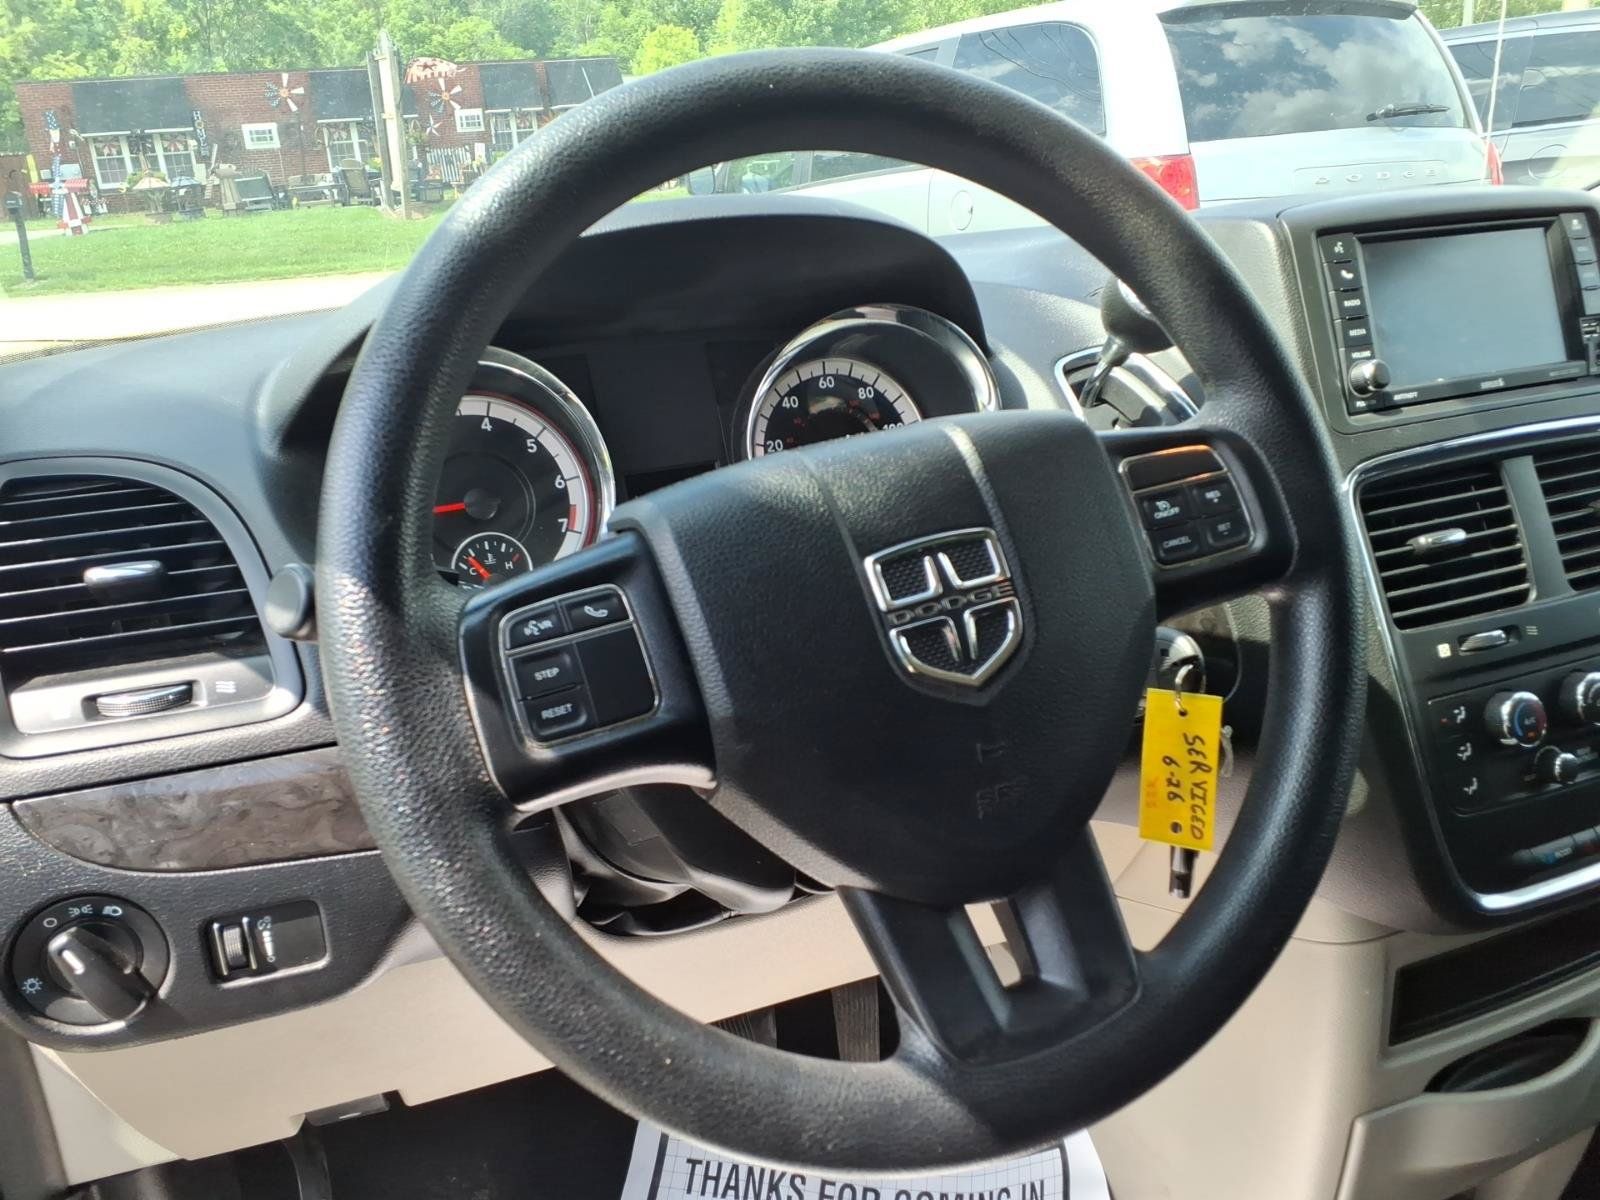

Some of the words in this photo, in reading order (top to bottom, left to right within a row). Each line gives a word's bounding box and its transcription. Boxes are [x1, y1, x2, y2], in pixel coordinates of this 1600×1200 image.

[1315, 168, 1440, 185] DODGE
[818, 375, 835, 389] 60
[858, 386, 875, 399] 80
[782, 395, 799, 409] 40
[481, 417, 493, 432] 4
[526, 439, 538, 453] 5
[766, 439, 784, 453] 20
[555, 475, 566, 489] 6
[557, 518, 569, 533] 7
[469, 566, 478, 576] C
[505, 561, 514, 570] H
[888, 581, 1014, 624] DODGE
[534, 667, 560, 681] STEP
[541, 703, 573, 720] RESET
[686, 1158, 807, 1200] THANKS
